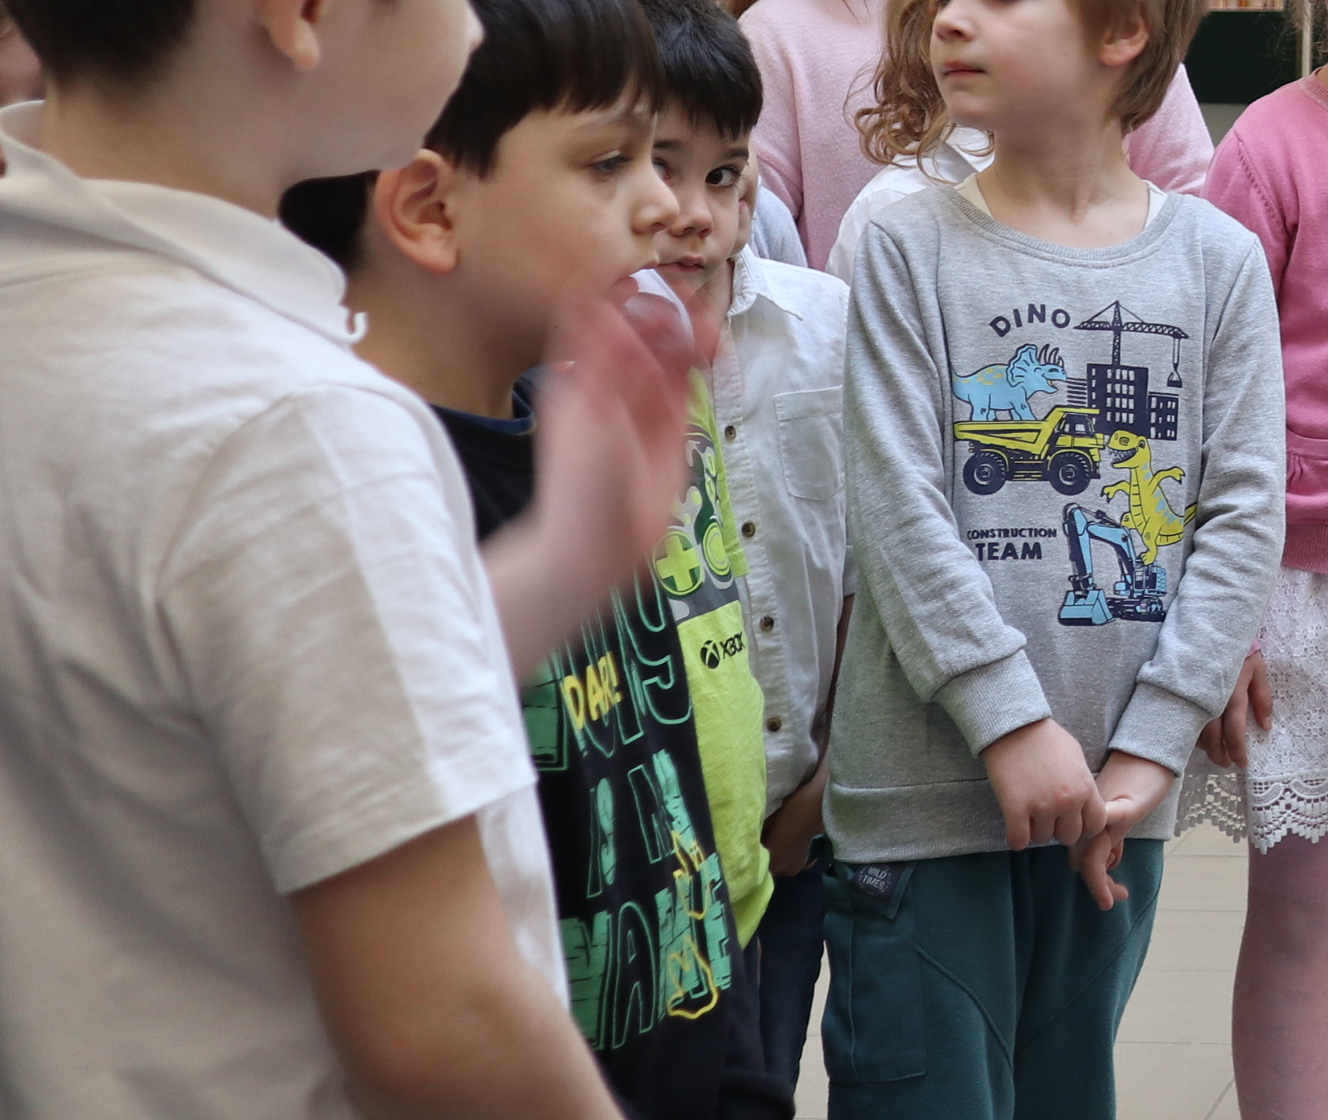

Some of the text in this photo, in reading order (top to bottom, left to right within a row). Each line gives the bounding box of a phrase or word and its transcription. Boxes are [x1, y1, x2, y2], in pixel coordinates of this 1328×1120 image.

[989, 303, 1071, 338] DINO
[966, 527, 1058, 541] CONSTRUCTION
[975, 541, 1043, 562] TEAM
[719, 630, 746, 660] XBOX
[867, 865, 888, 880] WILD
[862, 874, 886, 890] TIMES
